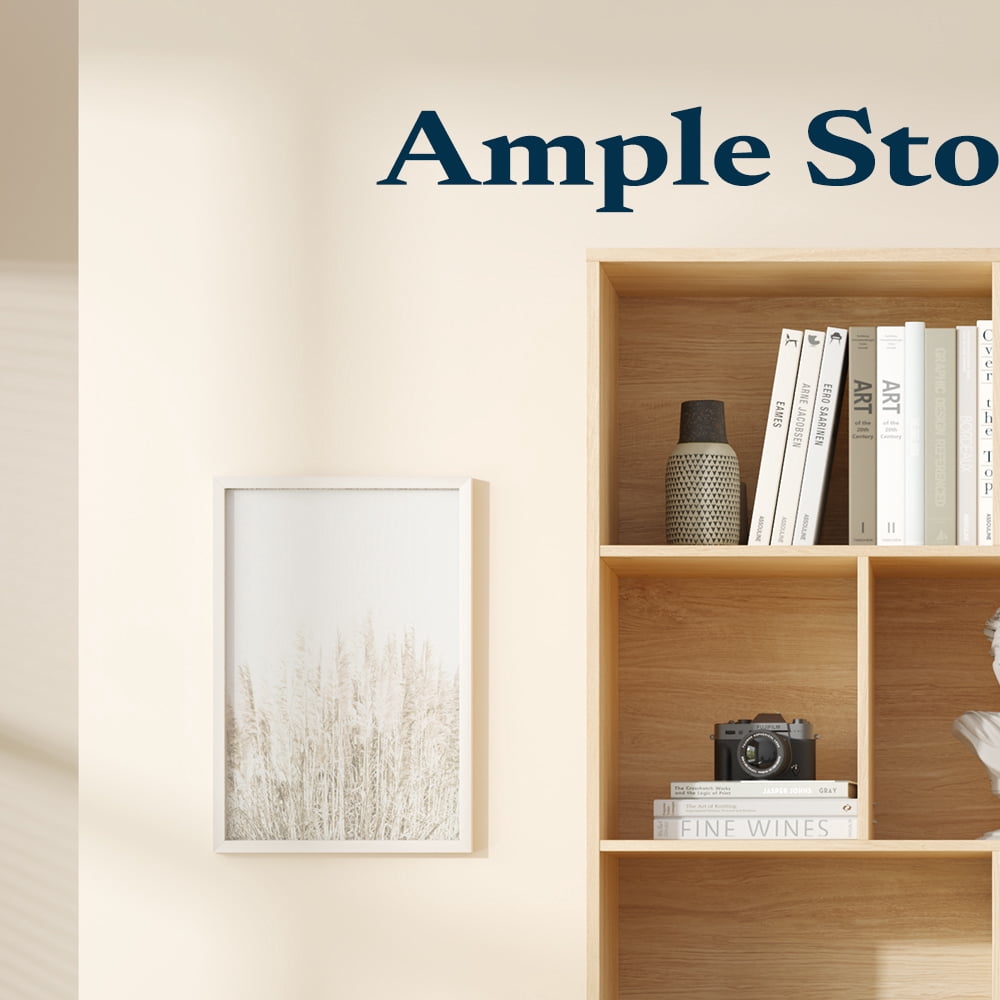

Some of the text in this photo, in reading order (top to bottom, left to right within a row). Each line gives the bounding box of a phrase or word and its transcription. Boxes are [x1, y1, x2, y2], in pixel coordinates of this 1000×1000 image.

[854, 380, 872, 414] ART
[882, 380, 900, 414] ART
[773, 401, 785, 428] EAMES
[792, 383, 811, 448] ARNE JACOBSEN
[815, 383, 833, 447] EERO SAARINEN
[681, 820, 735, 837] FINE
[747, 819, 829, 837] WINES
